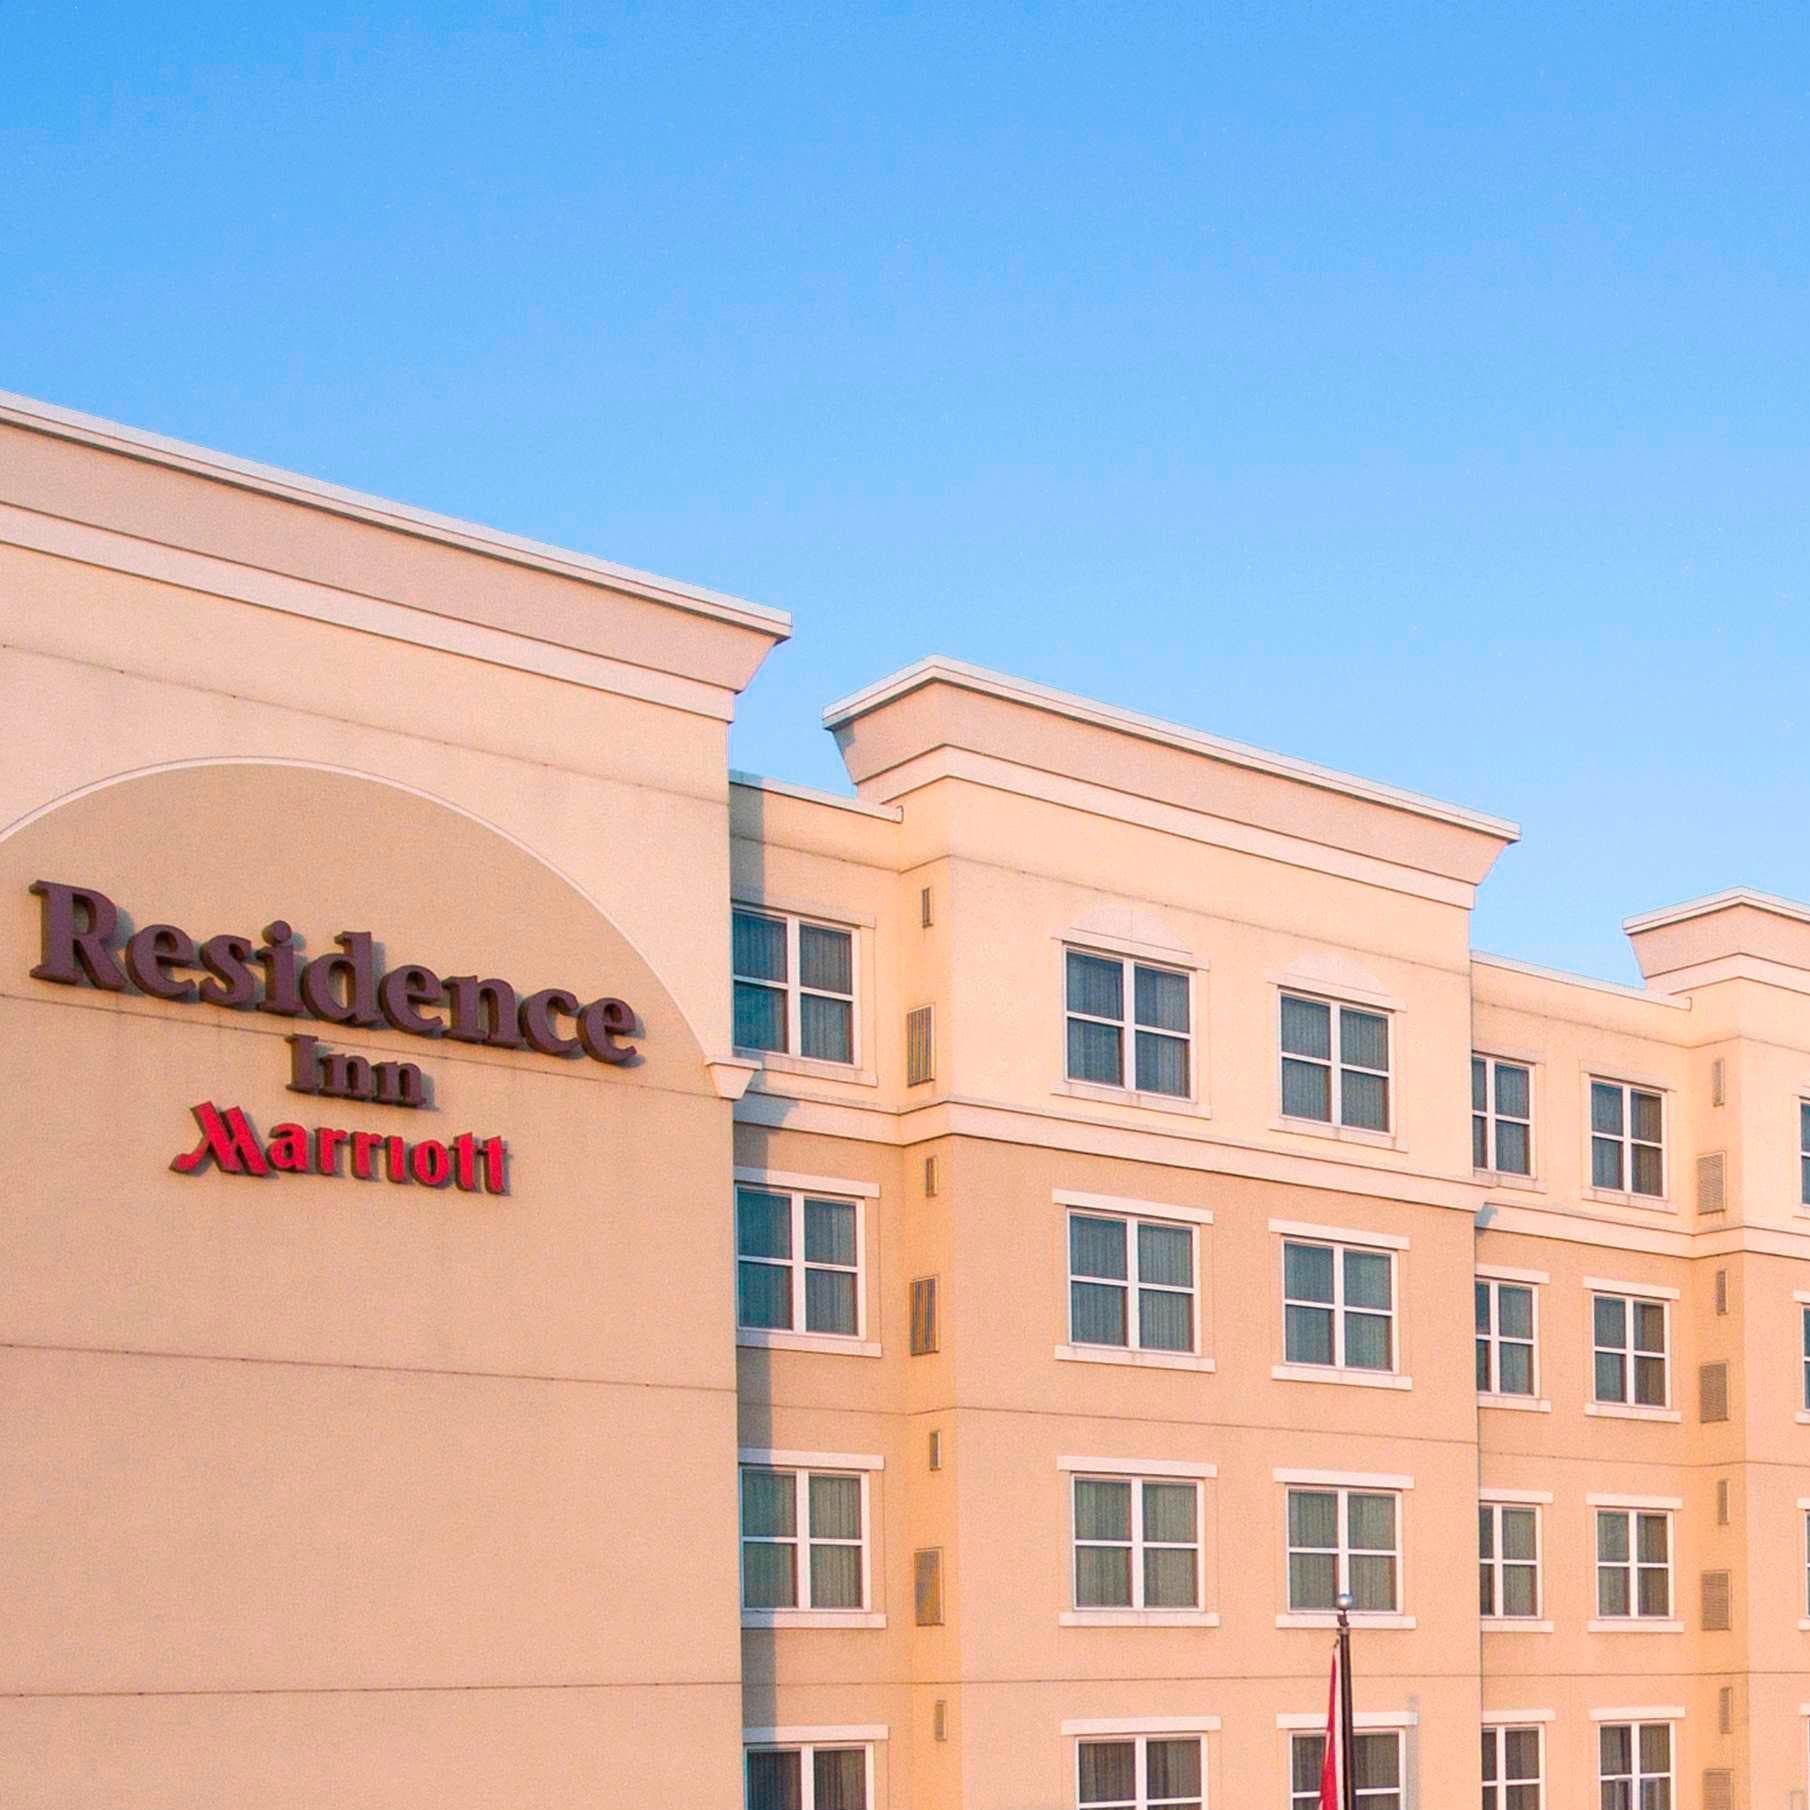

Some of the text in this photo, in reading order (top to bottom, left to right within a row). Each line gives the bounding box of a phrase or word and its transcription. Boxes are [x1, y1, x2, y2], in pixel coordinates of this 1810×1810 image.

[29, 880, 640, 1066] Residence
[285, 1033, 427, 1108] Inn
[169, 1100, 511, 1195] Marriott
